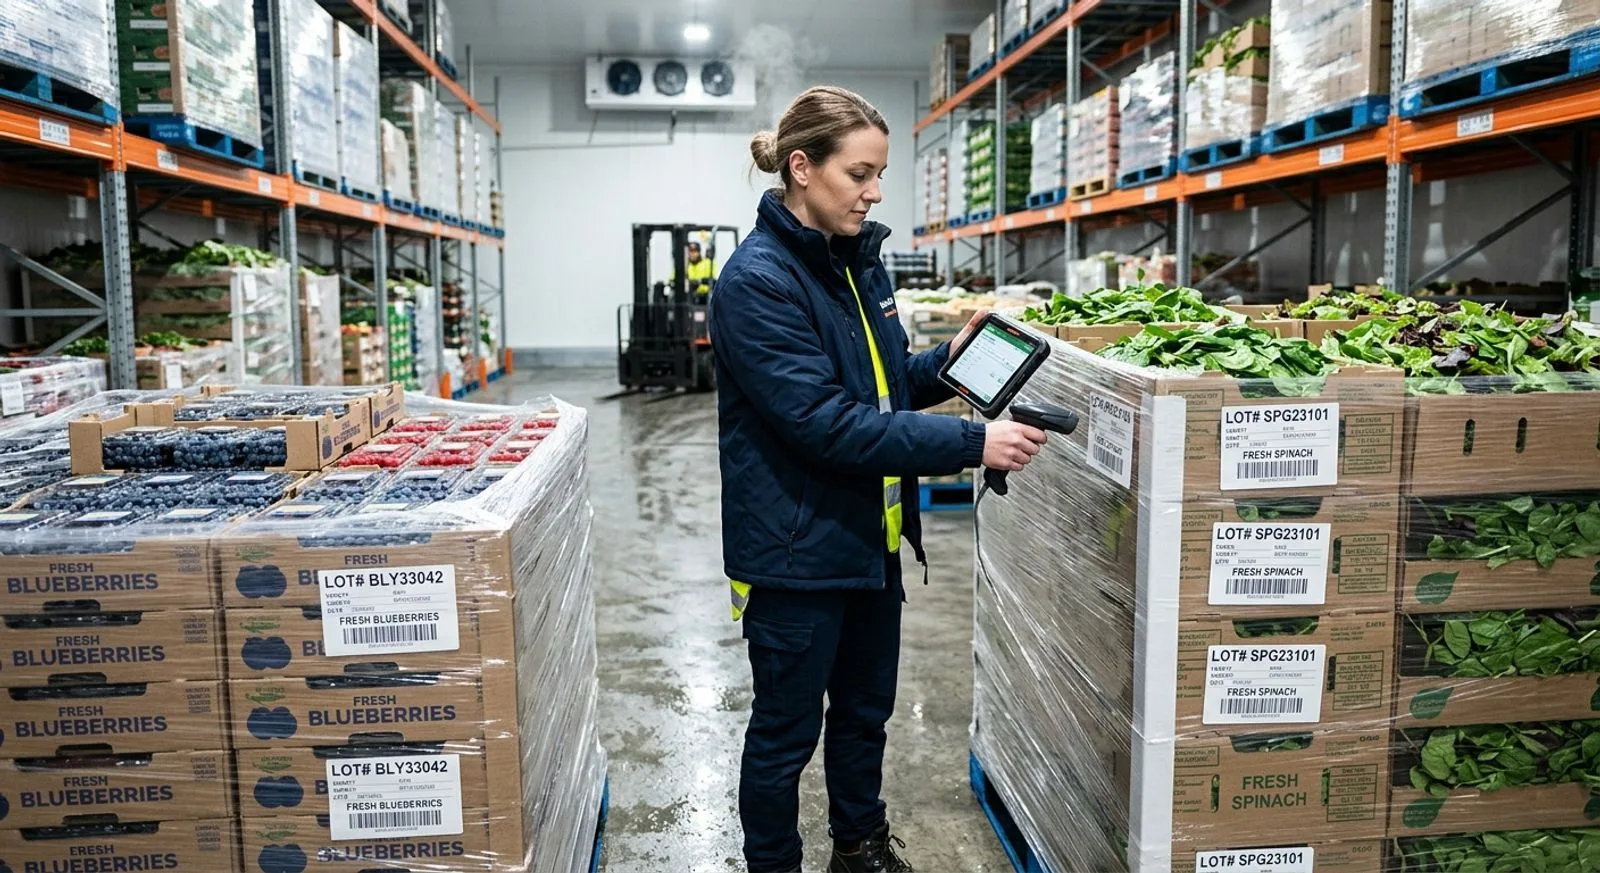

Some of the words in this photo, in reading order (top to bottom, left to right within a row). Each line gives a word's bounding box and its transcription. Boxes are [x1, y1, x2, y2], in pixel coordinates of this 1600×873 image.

[1226, 410, 1260, 424] LOT#
[1264, 408, 1328, 422] SPG23101
[1243, 450, 1272, 460] FRESH
[1274, 448, 1313, 458] SPINACH
[1217, 528, 1252, 540] LOT#
[1255, 528, 1320, 540] SPG23101
[344, 554, 388, 565] FRESH
[325, 574, 364, 588] LOT#
[369, 570, 443, 586] BLY33042
[1232, 567, 1262, 576] FRESH
[1263, 567, 1303, 576] SPINACH
[7, 573, 159, 594] BLUEBERRIES
[339, 615, 371, 626] FRESH
[373, 612, 440, 624] BLUEBERRIES
[56, 635, 100, 646] FRESH
[13, 645, 165, 667] BLUEBERRIES
[1211, 649, 1247, 662] LOT#
[1250, 649, 1316, 661] SPG23101
[1227, 687, 1257, 697] FRESH
[1258, 687, 1297, 696] SPINACH
[353, 695, 397, 706] FRESH
[59, 706, 104, 717] FRESH
[309, 705, 456, 726] BLUEBERRIES
[15, 716, 168, 738] BLUEBERRIES
[331, 763, 371, 777] LOT#
[375, 760, 448, 775] BLY33042
[64, 776, 109, 787] FRESH
[1242, 773, 1299, 790] FRESH
[20, 785, 173, 808] BLUEBERRIES
[1231, 792, 1307, 810] SPINACH
[346, 801, 377, 811] FRESH
[24, 853, 178, 873] BLUEBERRIES
[1201, 855, 1235, 868] LOT#
[1239, 852, 1303, 865] SPG23101
